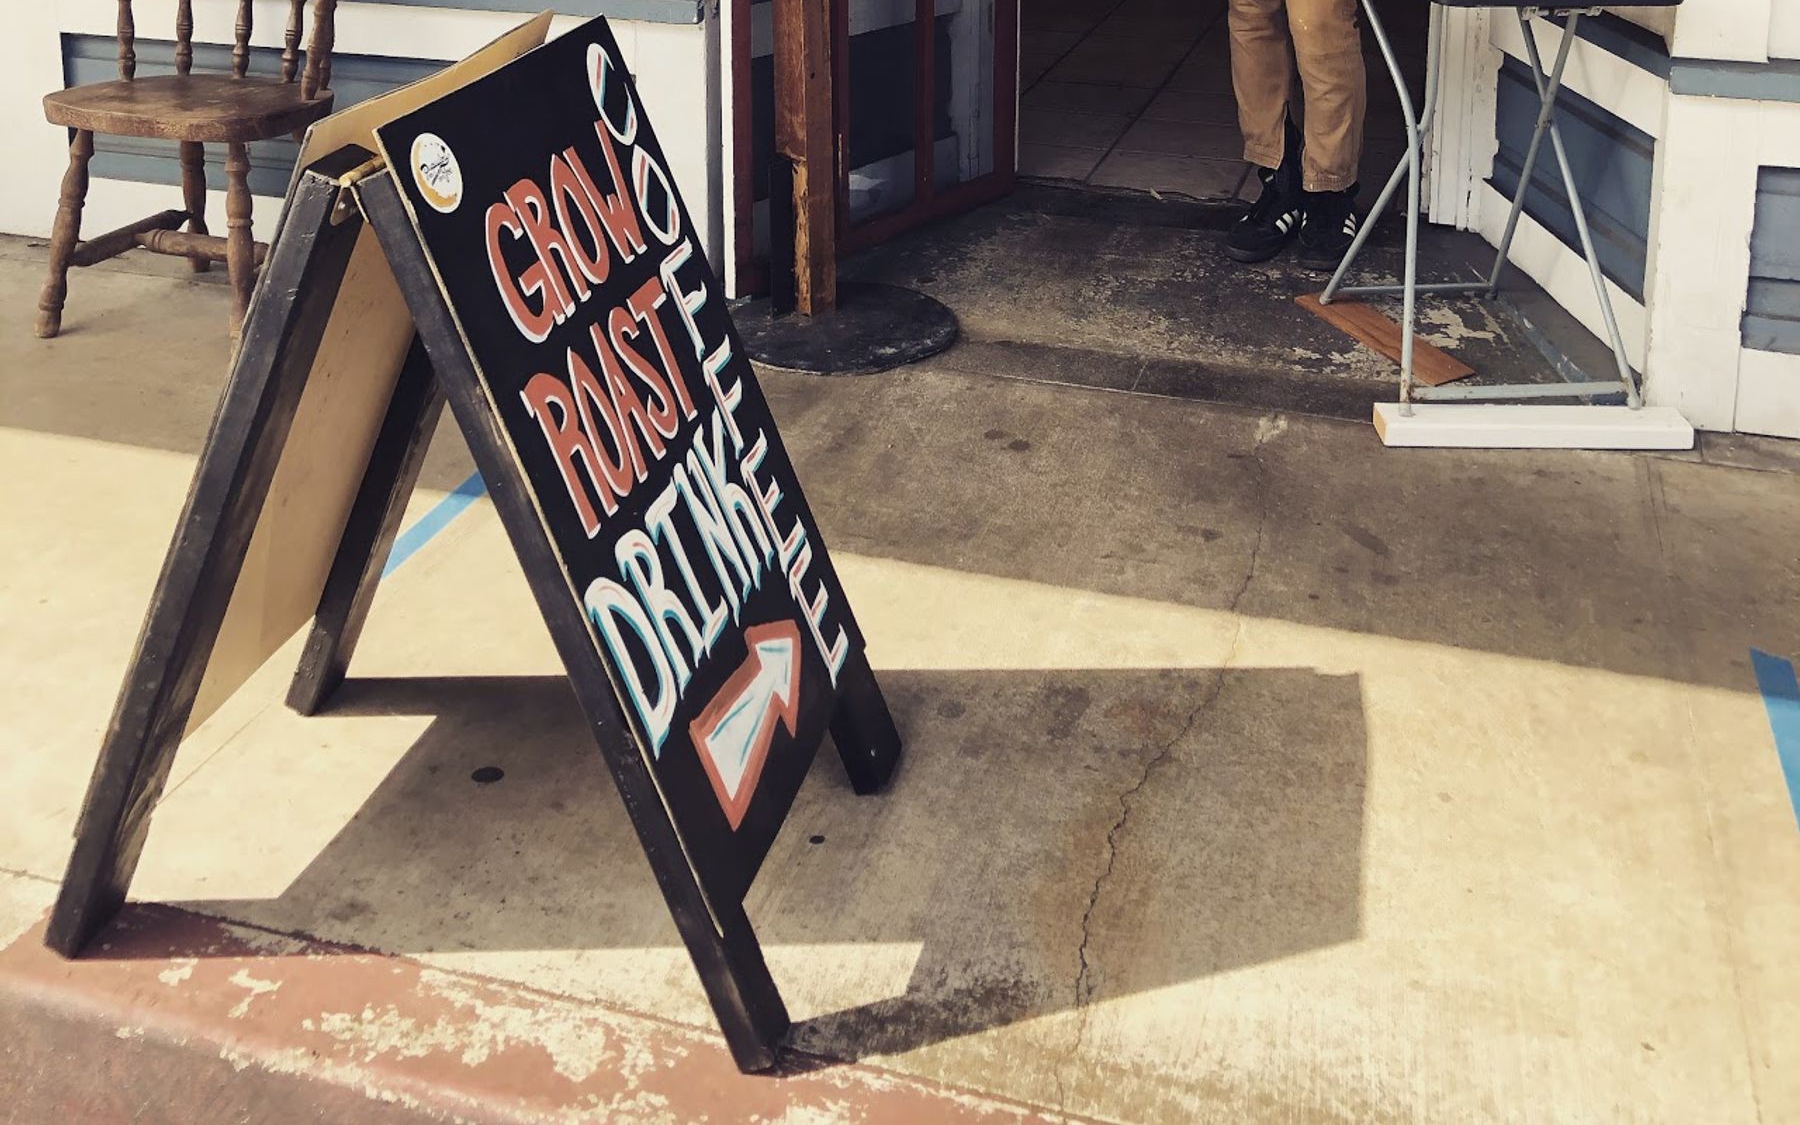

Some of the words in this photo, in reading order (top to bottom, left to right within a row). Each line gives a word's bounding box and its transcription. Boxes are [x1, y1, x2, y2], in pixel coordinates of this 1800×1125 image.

[485, 120, 648, 344] GROW
[519, 275, 699, 540] ROAST
[584, 405, 774, 761] DRINK
